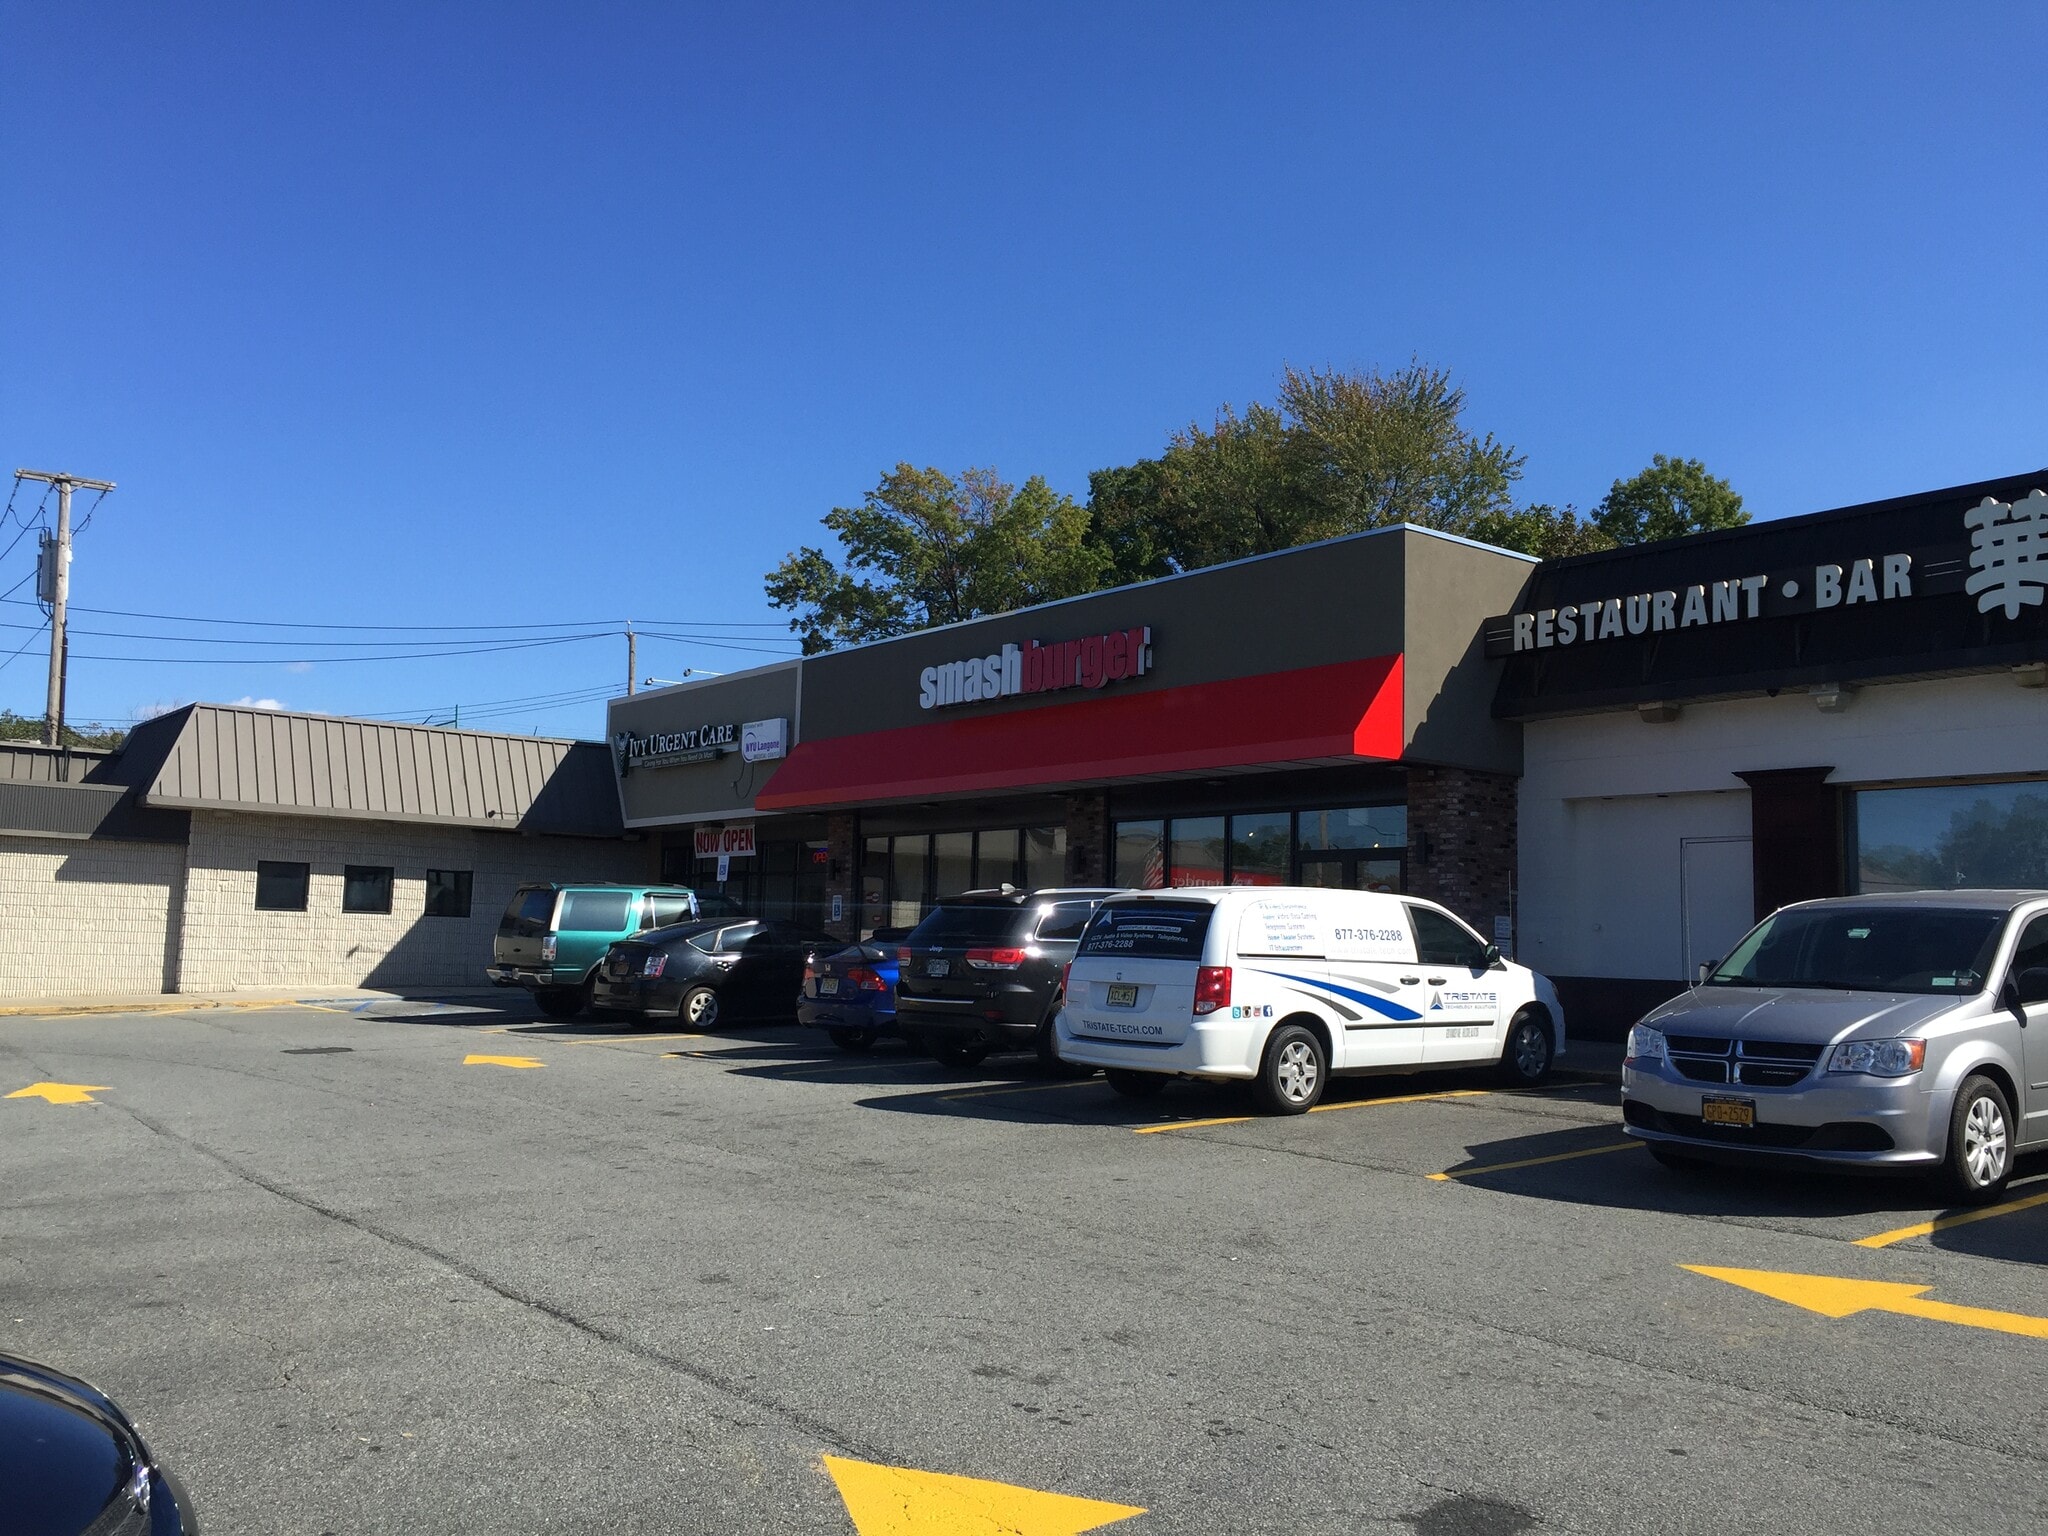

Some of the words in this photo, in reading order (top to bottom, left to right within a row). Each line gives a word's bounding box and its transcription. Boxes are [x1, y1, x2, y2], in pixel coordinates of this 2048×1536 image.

[1513, 574, 1769, 652] RESTAURANT
[1815, 553, 1912, 609] BAR
[919, 627, 1151, 709] smashburger
[650, 729, 698, 755] URGENT
[699, 723, 734, 747] CARE
[745, 742, 757, 752] NYU
[757, 741, 779, 752] Langone
[696, 831, 720, 854] NOW
[723, 828, 754, 852] OPEN
[1334, 928, 1403, 942] 877-376-2288
[928, 944, 943, 953] Jeep
[1087, 940, 1134, 951] 877-376-2288
[1443, 992, 1497, 1001] TRISTATE
[1082, 1019, 1163, 1036] TRISTATE-TECH.COM
